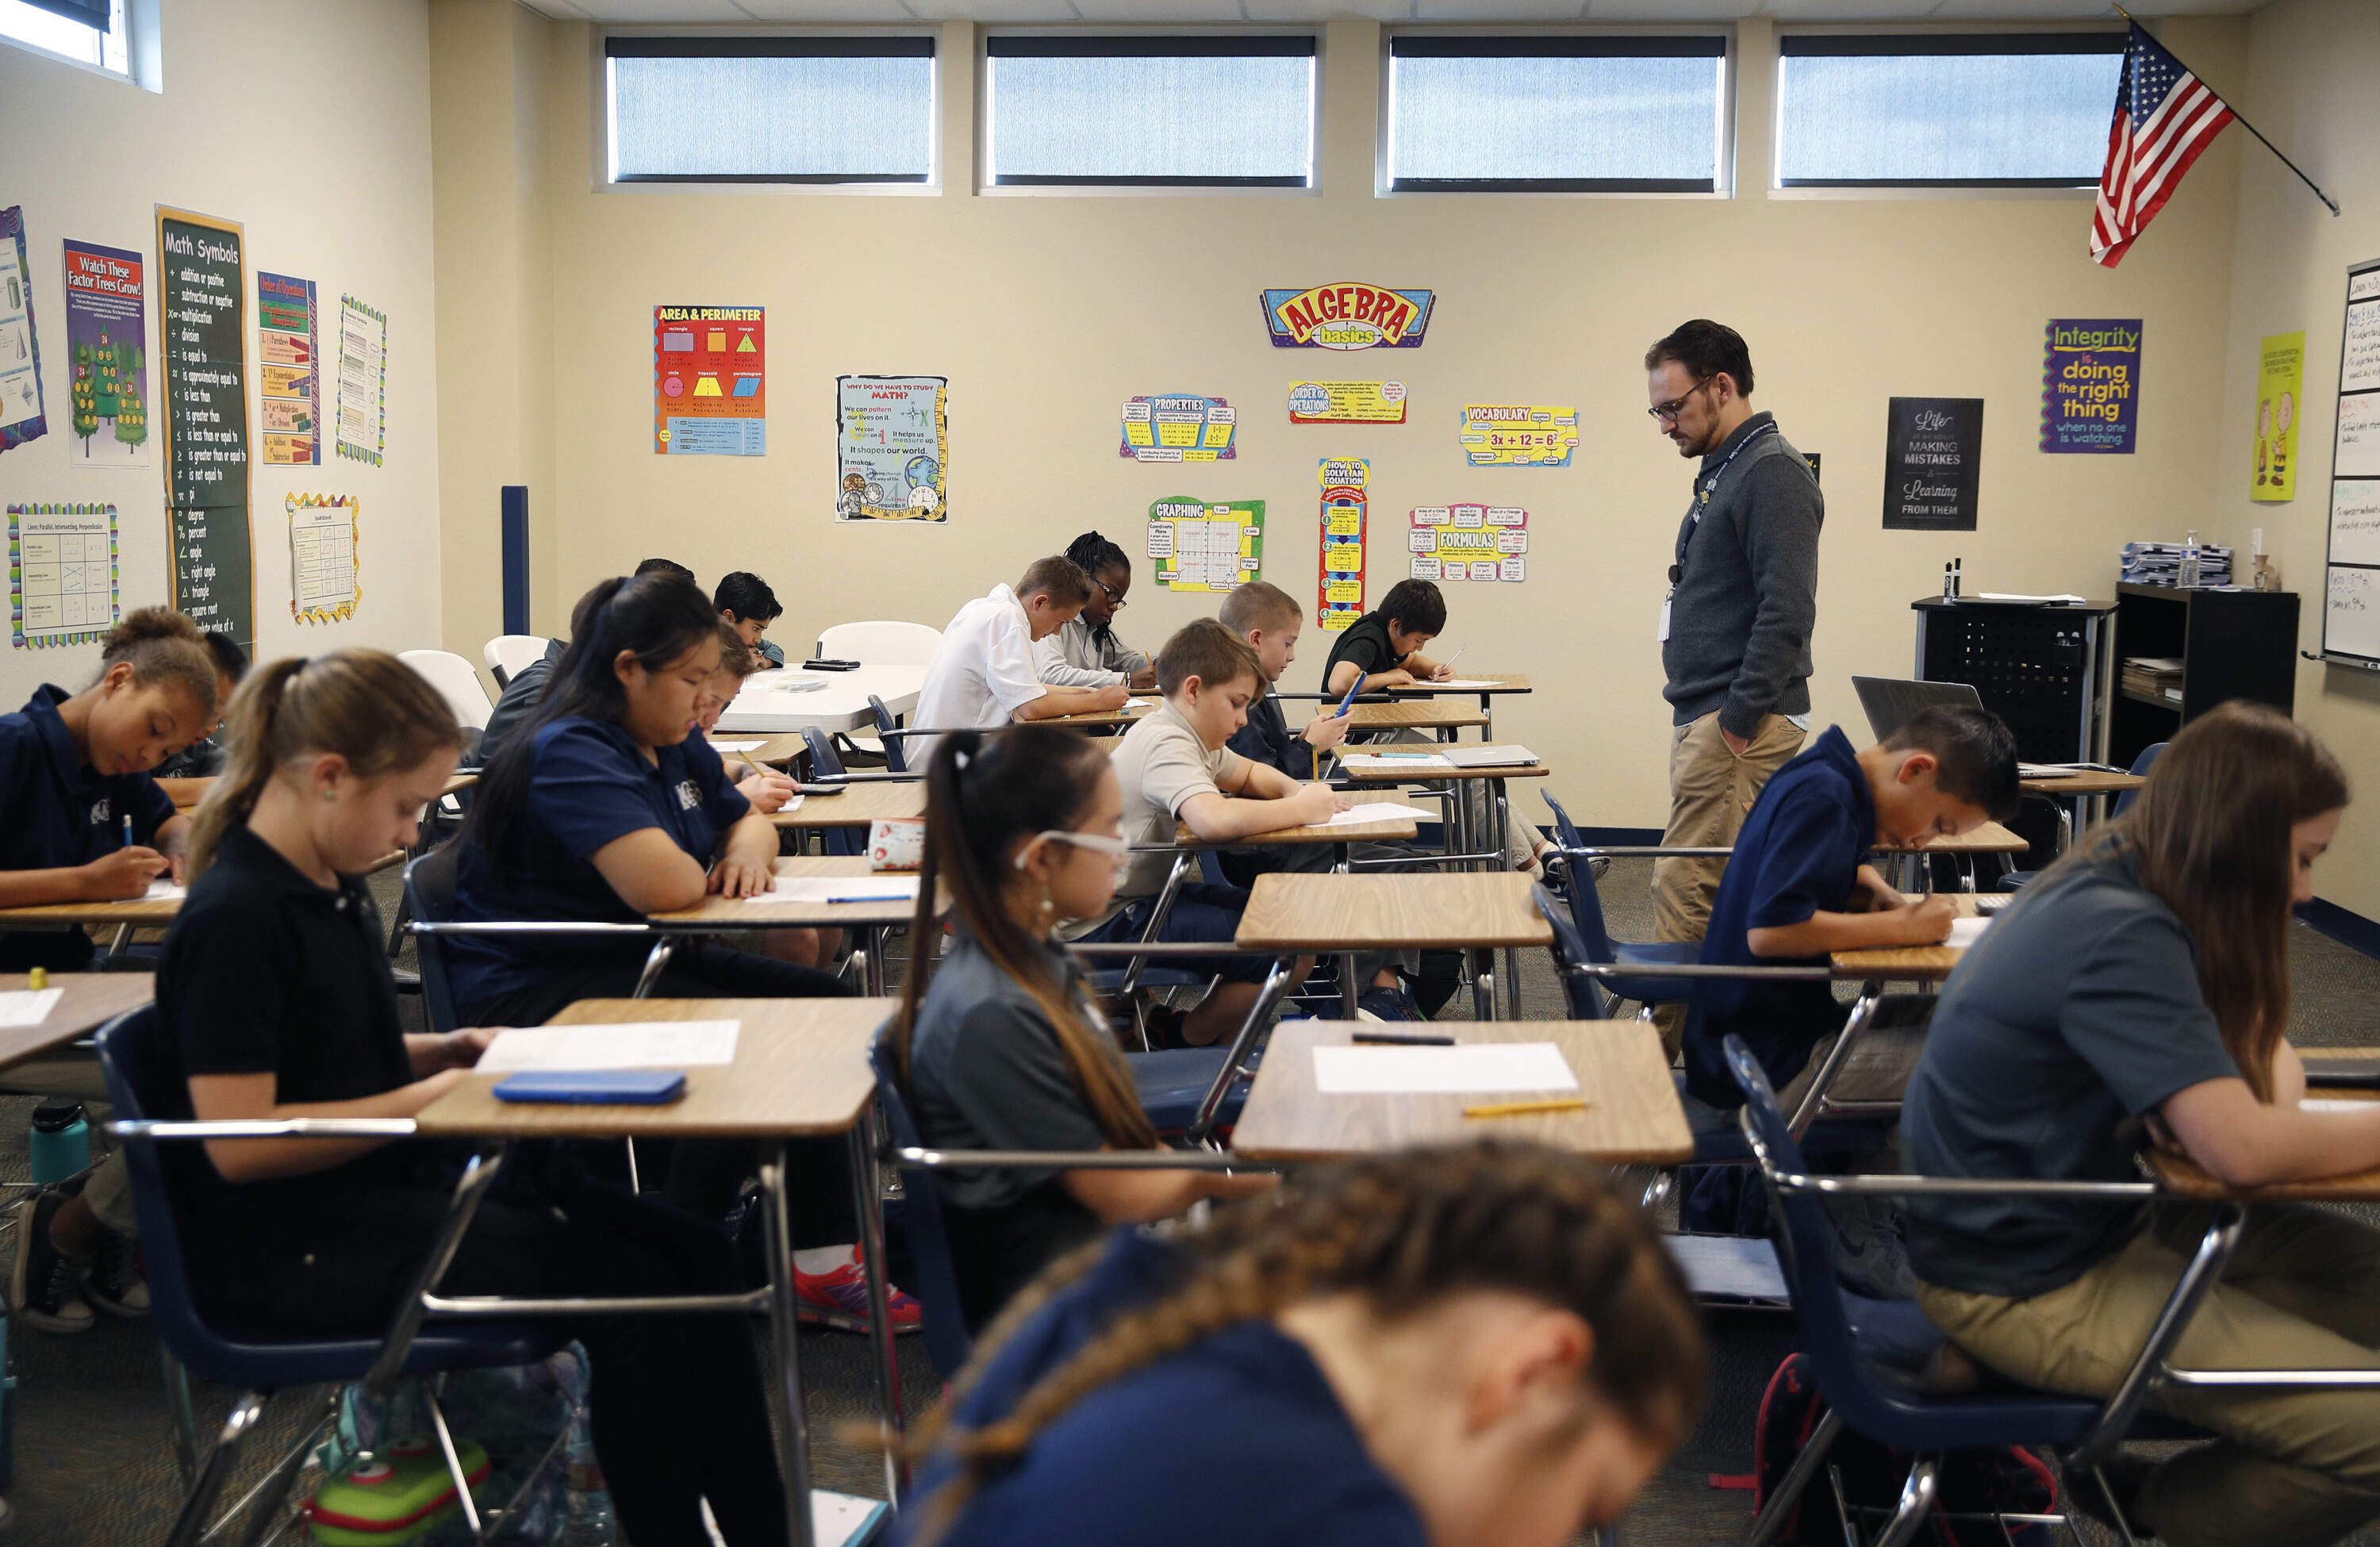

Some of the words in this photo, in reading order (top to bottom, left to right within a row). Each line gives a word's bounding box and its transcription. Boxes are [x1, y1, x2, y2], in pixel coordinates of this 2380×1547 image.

[166, 232, 194, 255] Math
[198, 239, 238, 264] Symbols
[79, 256, 106, 274] Watch
[108, 261, 129, 278] These
[181, 267, 200, 283] addition
[201, 274, 206, 283] or
[68, 271, 94, 288] Factor
[95, 275, 116, 292] Trees
[117, 279, 141, 296] Grow!
[182, 287, 208, 304] subtraction
[209, 295, 214, 305] or
[215, 294, 232, 310] negative
[182, 307, 212, 326] multiplication
[659, 309, 689, 320] AREA
[690, 309, 699, 321] &
[701, 309, 762, 321] PERIMETER
[1285, 287, 1410, 338] ALGEBRA
[102, 336, 108, 344] 24
[182, 327, 199, 343] division
[1320, 326, 1375, 344] basics
[2055, 327, 2139, 350] Integrity
[182, 347, 186, 361] is
[188, 348, 200, 366] equal
[202, 351, 207, 363] to
[2082, 352, 2092, 363] is
[79, 367, 85, 376] 24
[183, 368, 187, 381] is
[189, 370, 219, 387] approximately
[221, 371, 231, 389] equal
[232, 373, 238, 386] to
[2063, 361, 2128, 383] doing
[184, 388, 189, 401] is
[190, 387, 199, 401] less
[200, 388, 210, 402] than
[1294, 387, 1316, 399] ORDER
[1318, 387, 1326, 397] OF
[2058, 382, 2078, 393] the
[2079, 381, 2131, 403] right
[1154, 398, 1204, 411] PROPERTIES
[1289, 400, 1329, 411] OPERATIONS
[2063, 399, 2119, 421] thing
[186, 408, 190, 420] is
[192, 409, 209, 425] greater
[209, 409, 220, 422] than
[1468, 408, 1530, 420] VOCABULARY
[1915, 410, 1953, 431] Life
[2056, 422, 2086, 432] when
[2089, 424, 2103, 432] no
[2106, 424, 2127, 432] one
[187, 428, 192, 441] is
[193, 427, 202, 441] less
[203, 427, 214, 441] than
[214, 432, 219, 442] or
[221, 428, 232, 446] equal
[232, 430, 237, 443] to
[1491, 435, 1503, 445] 3x
[1519, 435, 1531, 445] 12
[2060, 433, 2069, 443] is
[2072, 433, 2124, 445] watching.
[1909, 441, 1957, 451] MAKING
[189, 447, 193, 460] is
[194, 449, 212, 465] greater
[213, 447, 223, 461] than
[224, 452, 228, 461] or
[230, 447, 240, 466] equal
[241, 449, 246, 462] to
[1905, 454, 1960, 465] MISTAKES
[189, 467, 194, 480] is
[205, 466, 217, 485] equal
[217, 468, 222, 481] to
[190, 486, 194, 504] pi
[1903, 479, 1957, 501] Learning
[188, 508, 205, 525] degree
[1157, 504, 1204, 518] GRAPHING
[1902, 505, 1929, 514] FROM
[1933, 505, 1957, 514] THEM
[188, 525, 206, 543] percent
[1440, 532, 1495, 547] FORMULAS
[190, 543, 202, 562] angle
[191, 565, 202, 582] right
[204, 562, 216, 581] angle
[192, 583, 209, 601] triangle
[192, 605, 206, 620] square
[208, 602, 217, 615] root
[212, 620, 224, 632] value
[224, 618, 229, 631] of
[230, 620, 234, 631] x
